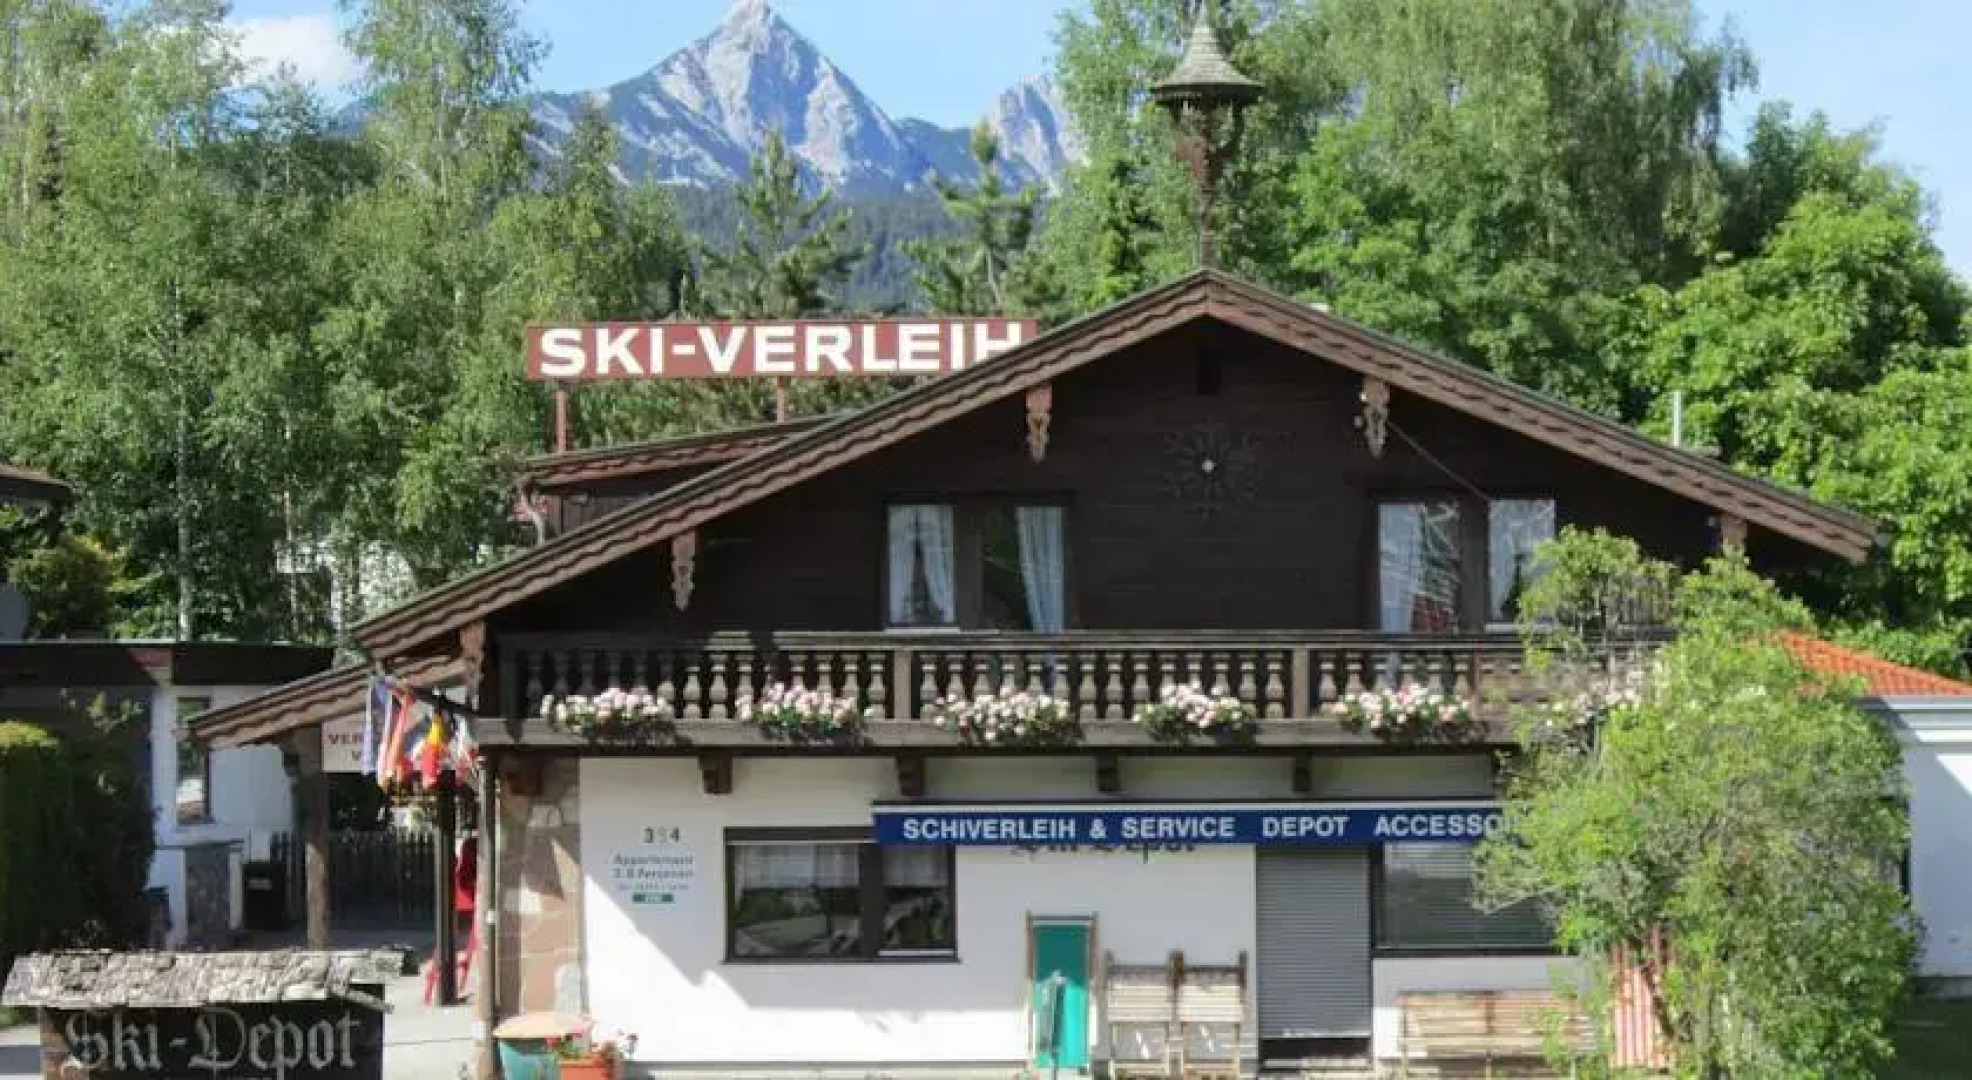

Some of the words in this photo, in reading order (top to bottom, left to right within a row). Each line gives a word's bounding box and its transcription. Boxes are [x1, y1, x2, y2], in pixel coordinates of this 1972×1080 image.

[539, 323, 1022, 377] SKI-VERLEIH
[902, 818, 1076, 840] SCHIVERLEIH
[1089, 818, 1107, 839] &
[1121, 816, 1236, 839] SERVICE
[1262, 815, 1350, 838] DEPOT
[1373, 813, 1506, 838] ACCESSO
[65, 1005, 360, 1080] Ski-Depot
